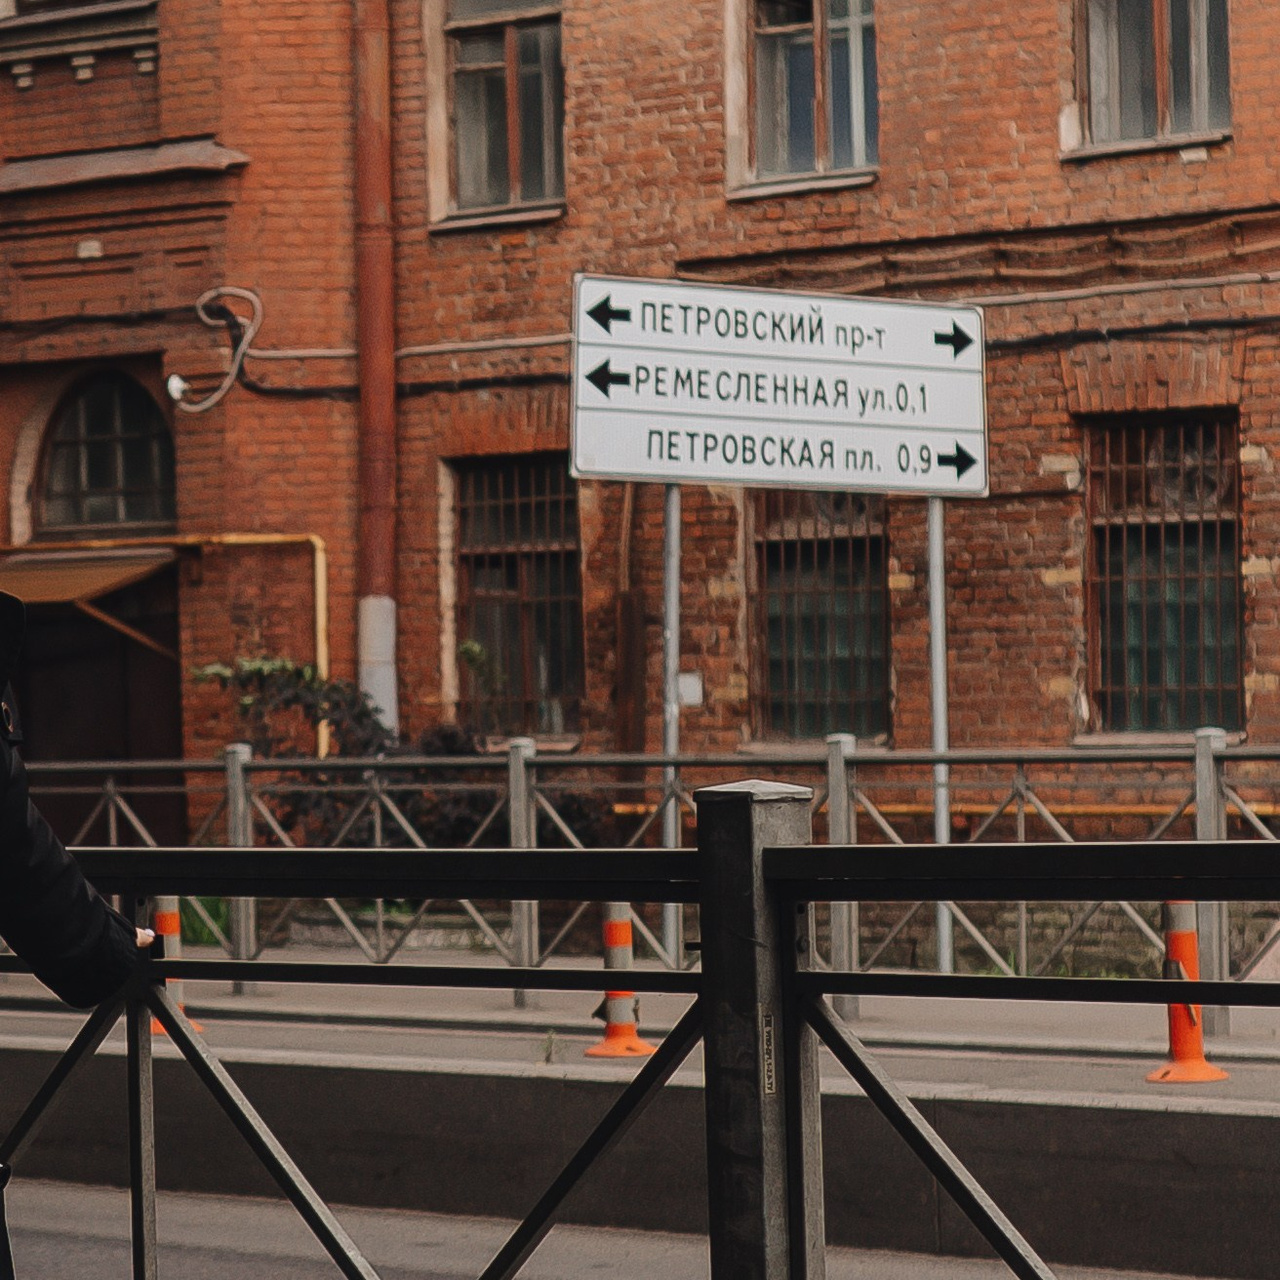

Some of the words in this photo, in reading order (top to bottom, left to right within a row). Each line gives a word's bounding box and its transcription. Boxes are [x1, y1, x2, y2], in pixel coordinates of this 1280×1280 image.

[641, 302, 825, 345] ПЕТРОВСКИЙ
[835, 325, 887, 356] пр-т
[635, 365, 848, 407] РЕМЕСЛЕННАЯ
[647, 429, 836, 470] ПЕТРОВСКАЯ
[845, 450, 882, 472] пл.
[897, 444, 932, 474] 0,9
